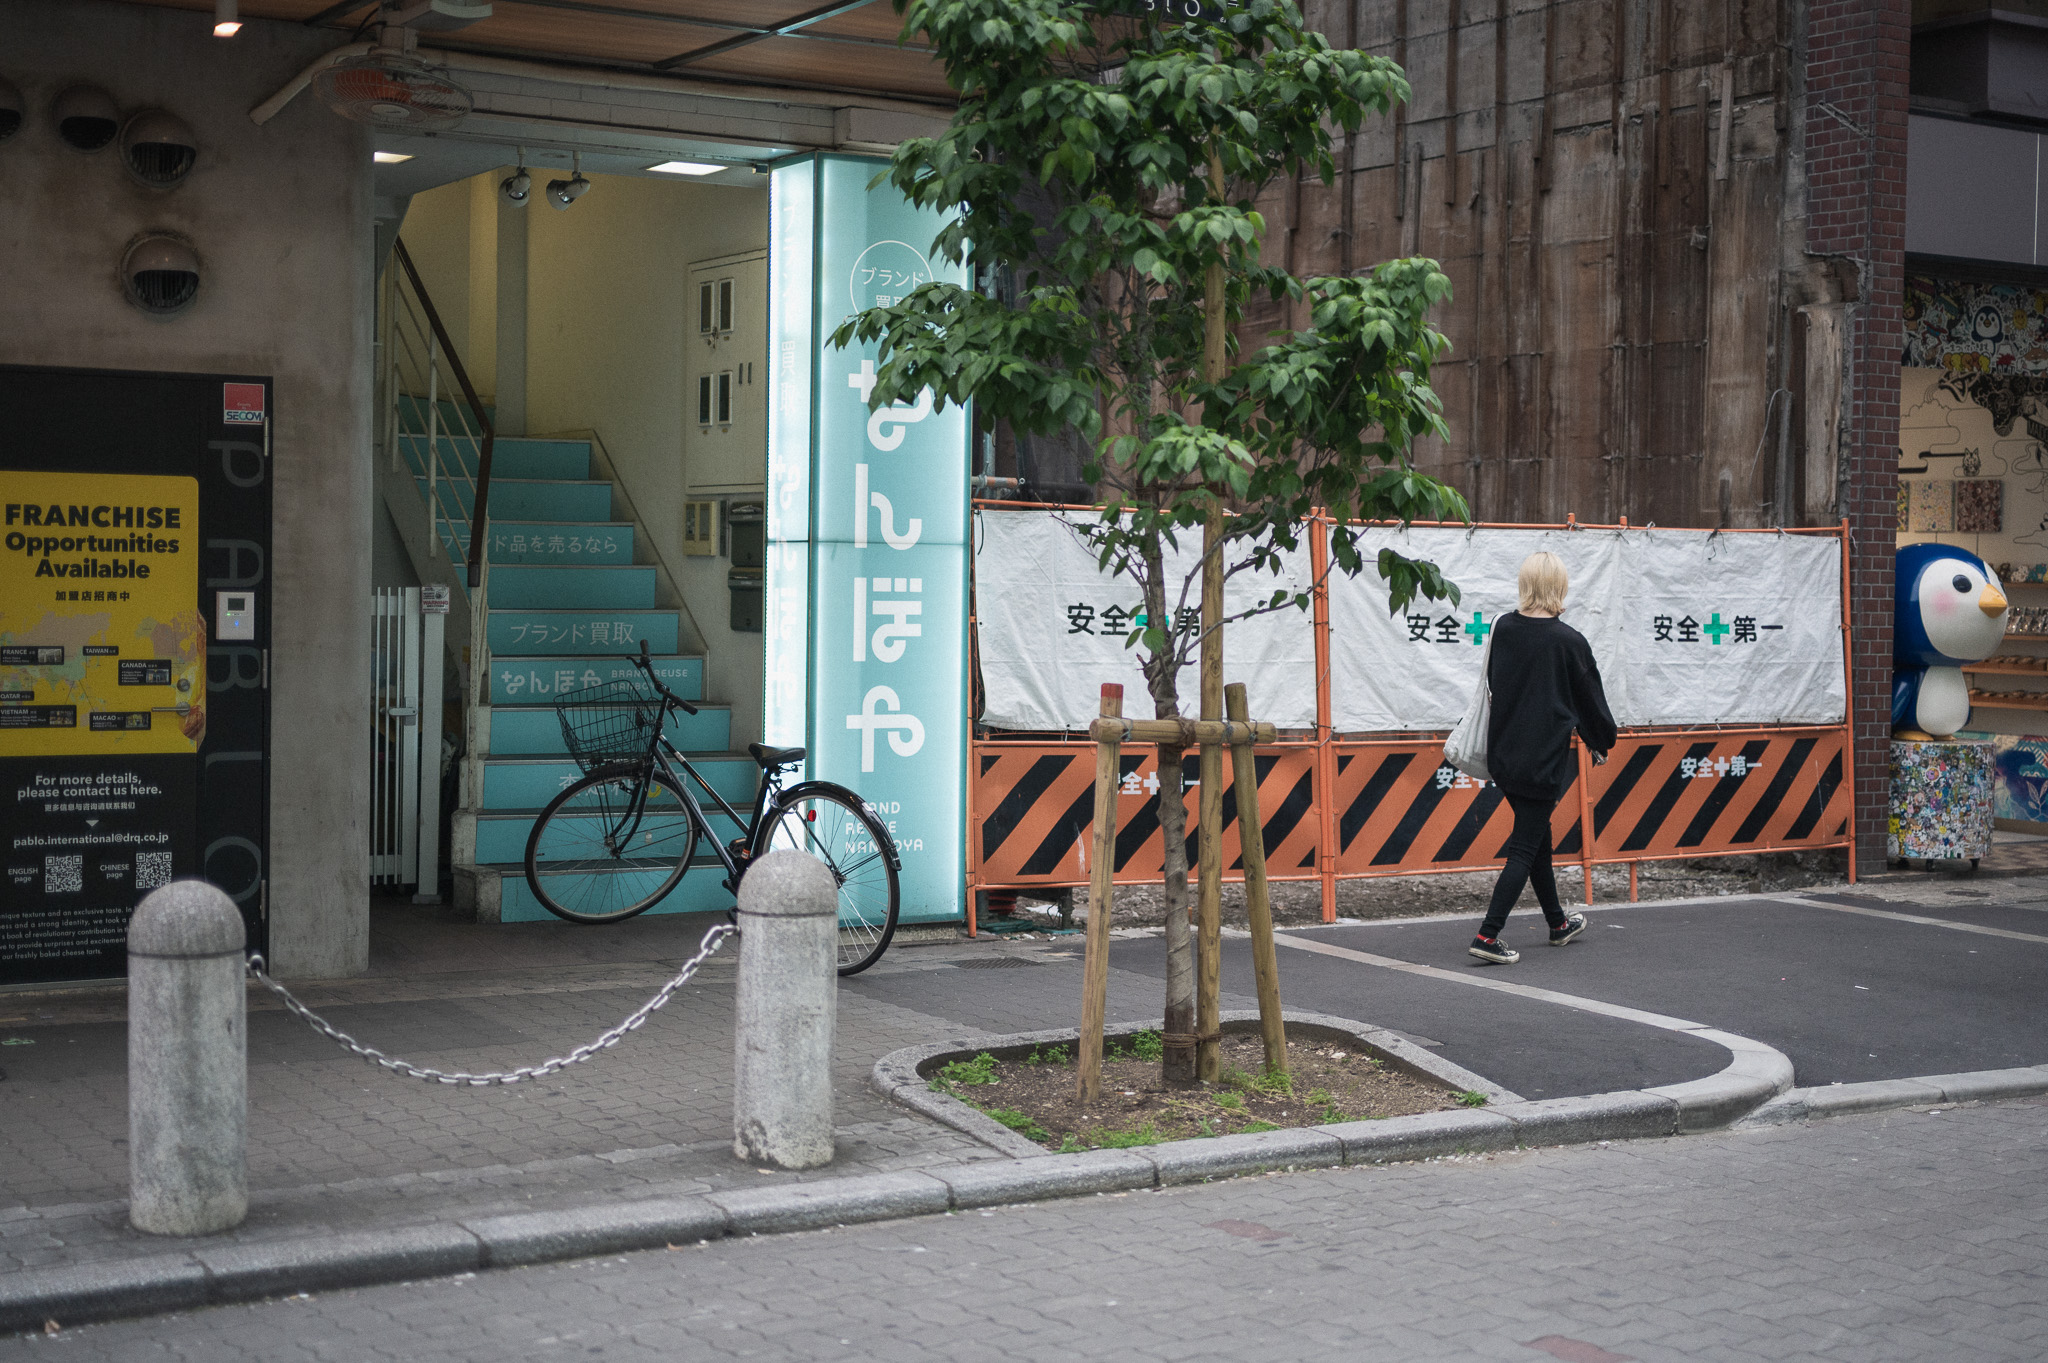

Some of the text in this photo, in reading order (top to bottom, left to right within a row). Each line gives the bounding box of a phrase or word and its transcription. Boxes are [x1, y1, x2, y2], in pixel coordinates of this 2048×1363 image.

[861, 266, 924, 289] ブランド
[226, 411, 262, 421] SECOM
[5, 503, 181, 529] FRANCHISE
[5, 531, 180, 557] Opportunities
[35, 558, 150, 578] Available
[55, 590, 130, 602] 加盟店招商中
[1067, 602, 1129, 635] 安全
[510, 622, 634, 646] ブランド買取
[1407, 613, 1461, 643] 安全
[1654, 614, 1783, 643] 安全 第一
[501, 669, 603, 694] なんぼや
[611, 669, 688, 678] BRAND REUSE
[1681, 756, 1763, 778] 安全 第一
[35, 772, 141, 785] For more details,
[1436, 767, 1473, 789] 安全
[17, 784, 162, 801] please contact us here.
[845, 821, 897, 835] REE
[13, 832, 169, 849] pablo.international@drq.co.jp
[845, 838, 923, 854] NANOYA
[7, 867, 39, 875] ENGLISH
[99, 863, 130, 871] CHINESE
[14, 876, 32, 884] page
[47, 909, 61, 917] and
[73, 907, 104, 916] exclusive
[38, 921, 60, 929] strong
[61, 917, 91, 926] identity,
[32, 929, 75, 938] revolutionary
[77, 927, 116, 935] contribution
[17, 941, 43, 950] provide
[44, 939, 74, 948] surprises
[90, 936, 126, 945] excitement
[14, 951, 37, 960] freshly
[62, 948, 85, 956] cheese
